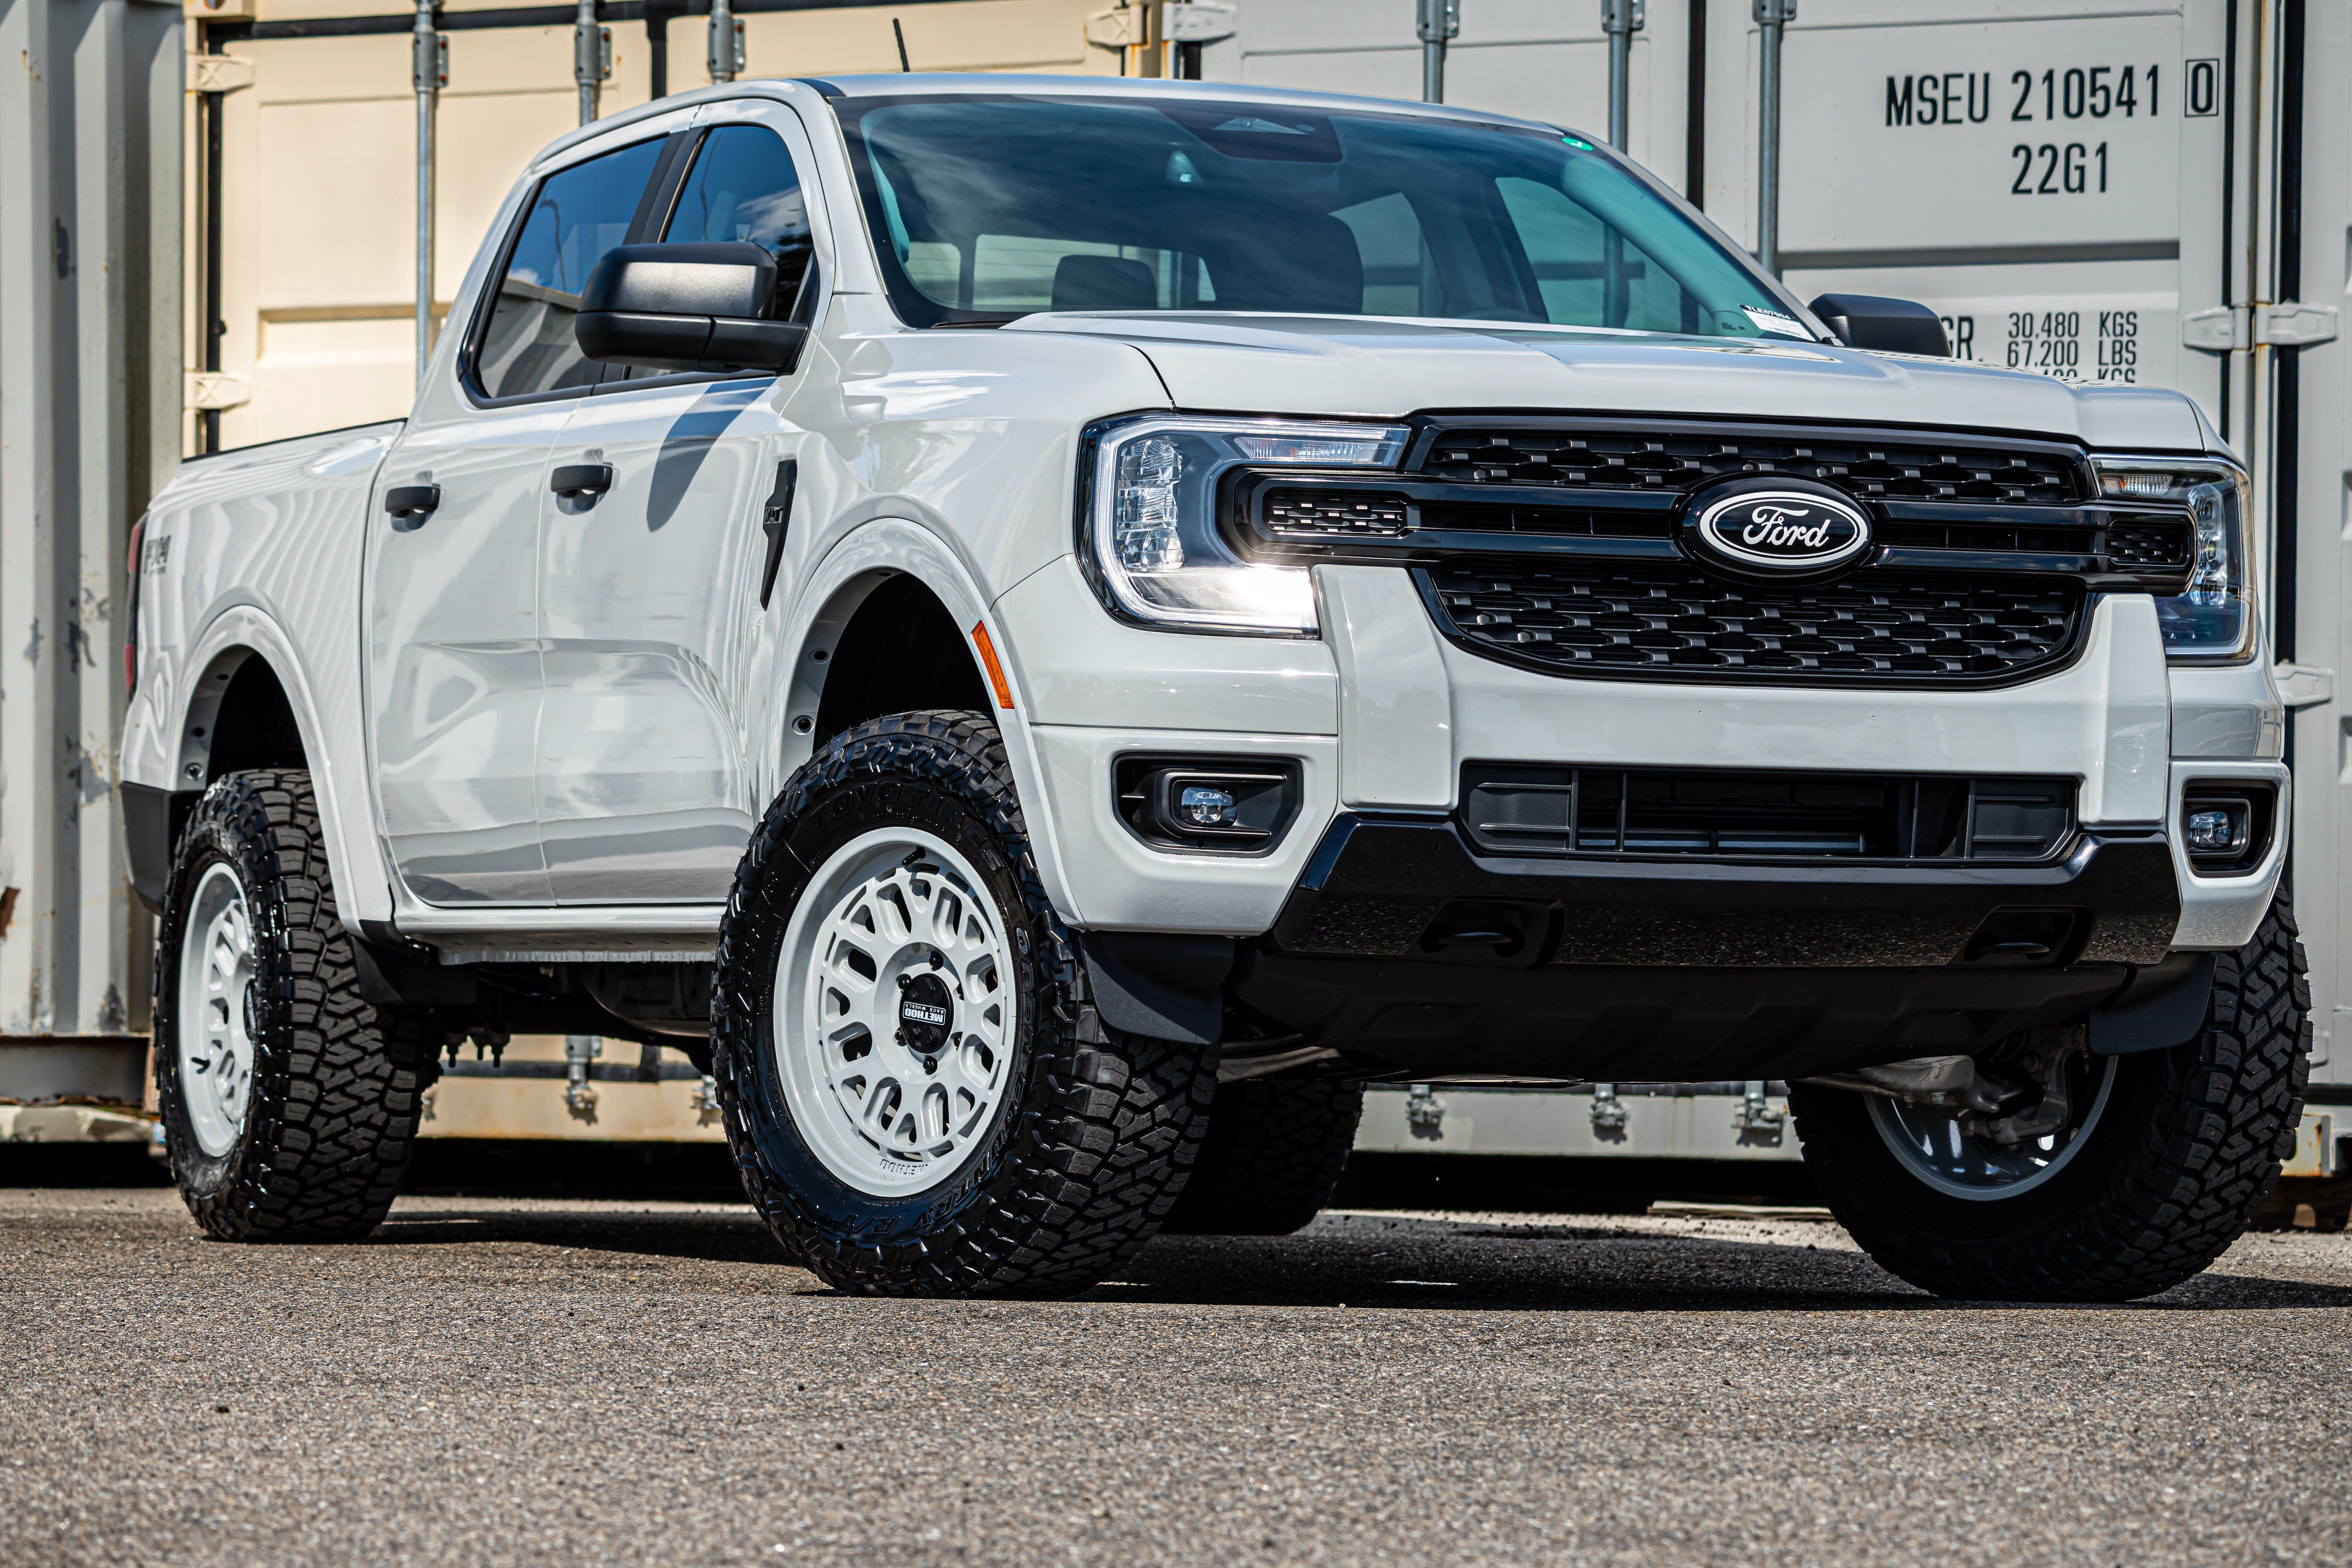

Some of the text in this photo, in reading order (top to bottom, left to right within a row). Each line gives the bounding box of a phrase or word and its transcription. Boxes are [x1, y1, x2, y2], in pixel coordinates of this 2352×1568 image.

[1885, 62, 2213, 127] MSEU 210541 0
[2011, 141, 2108, 195] 22G1
[2099, 311, 2138, 337] KGS
[2098, 339, 2136, 366] LBS
[1743, 506, 1831, 547] Ford
[809, 780, 1005, 875] TOYO TIRES
[904, 1008, 943, 1022] METHOD
[880, 1158, 929, 1175] METHOD
